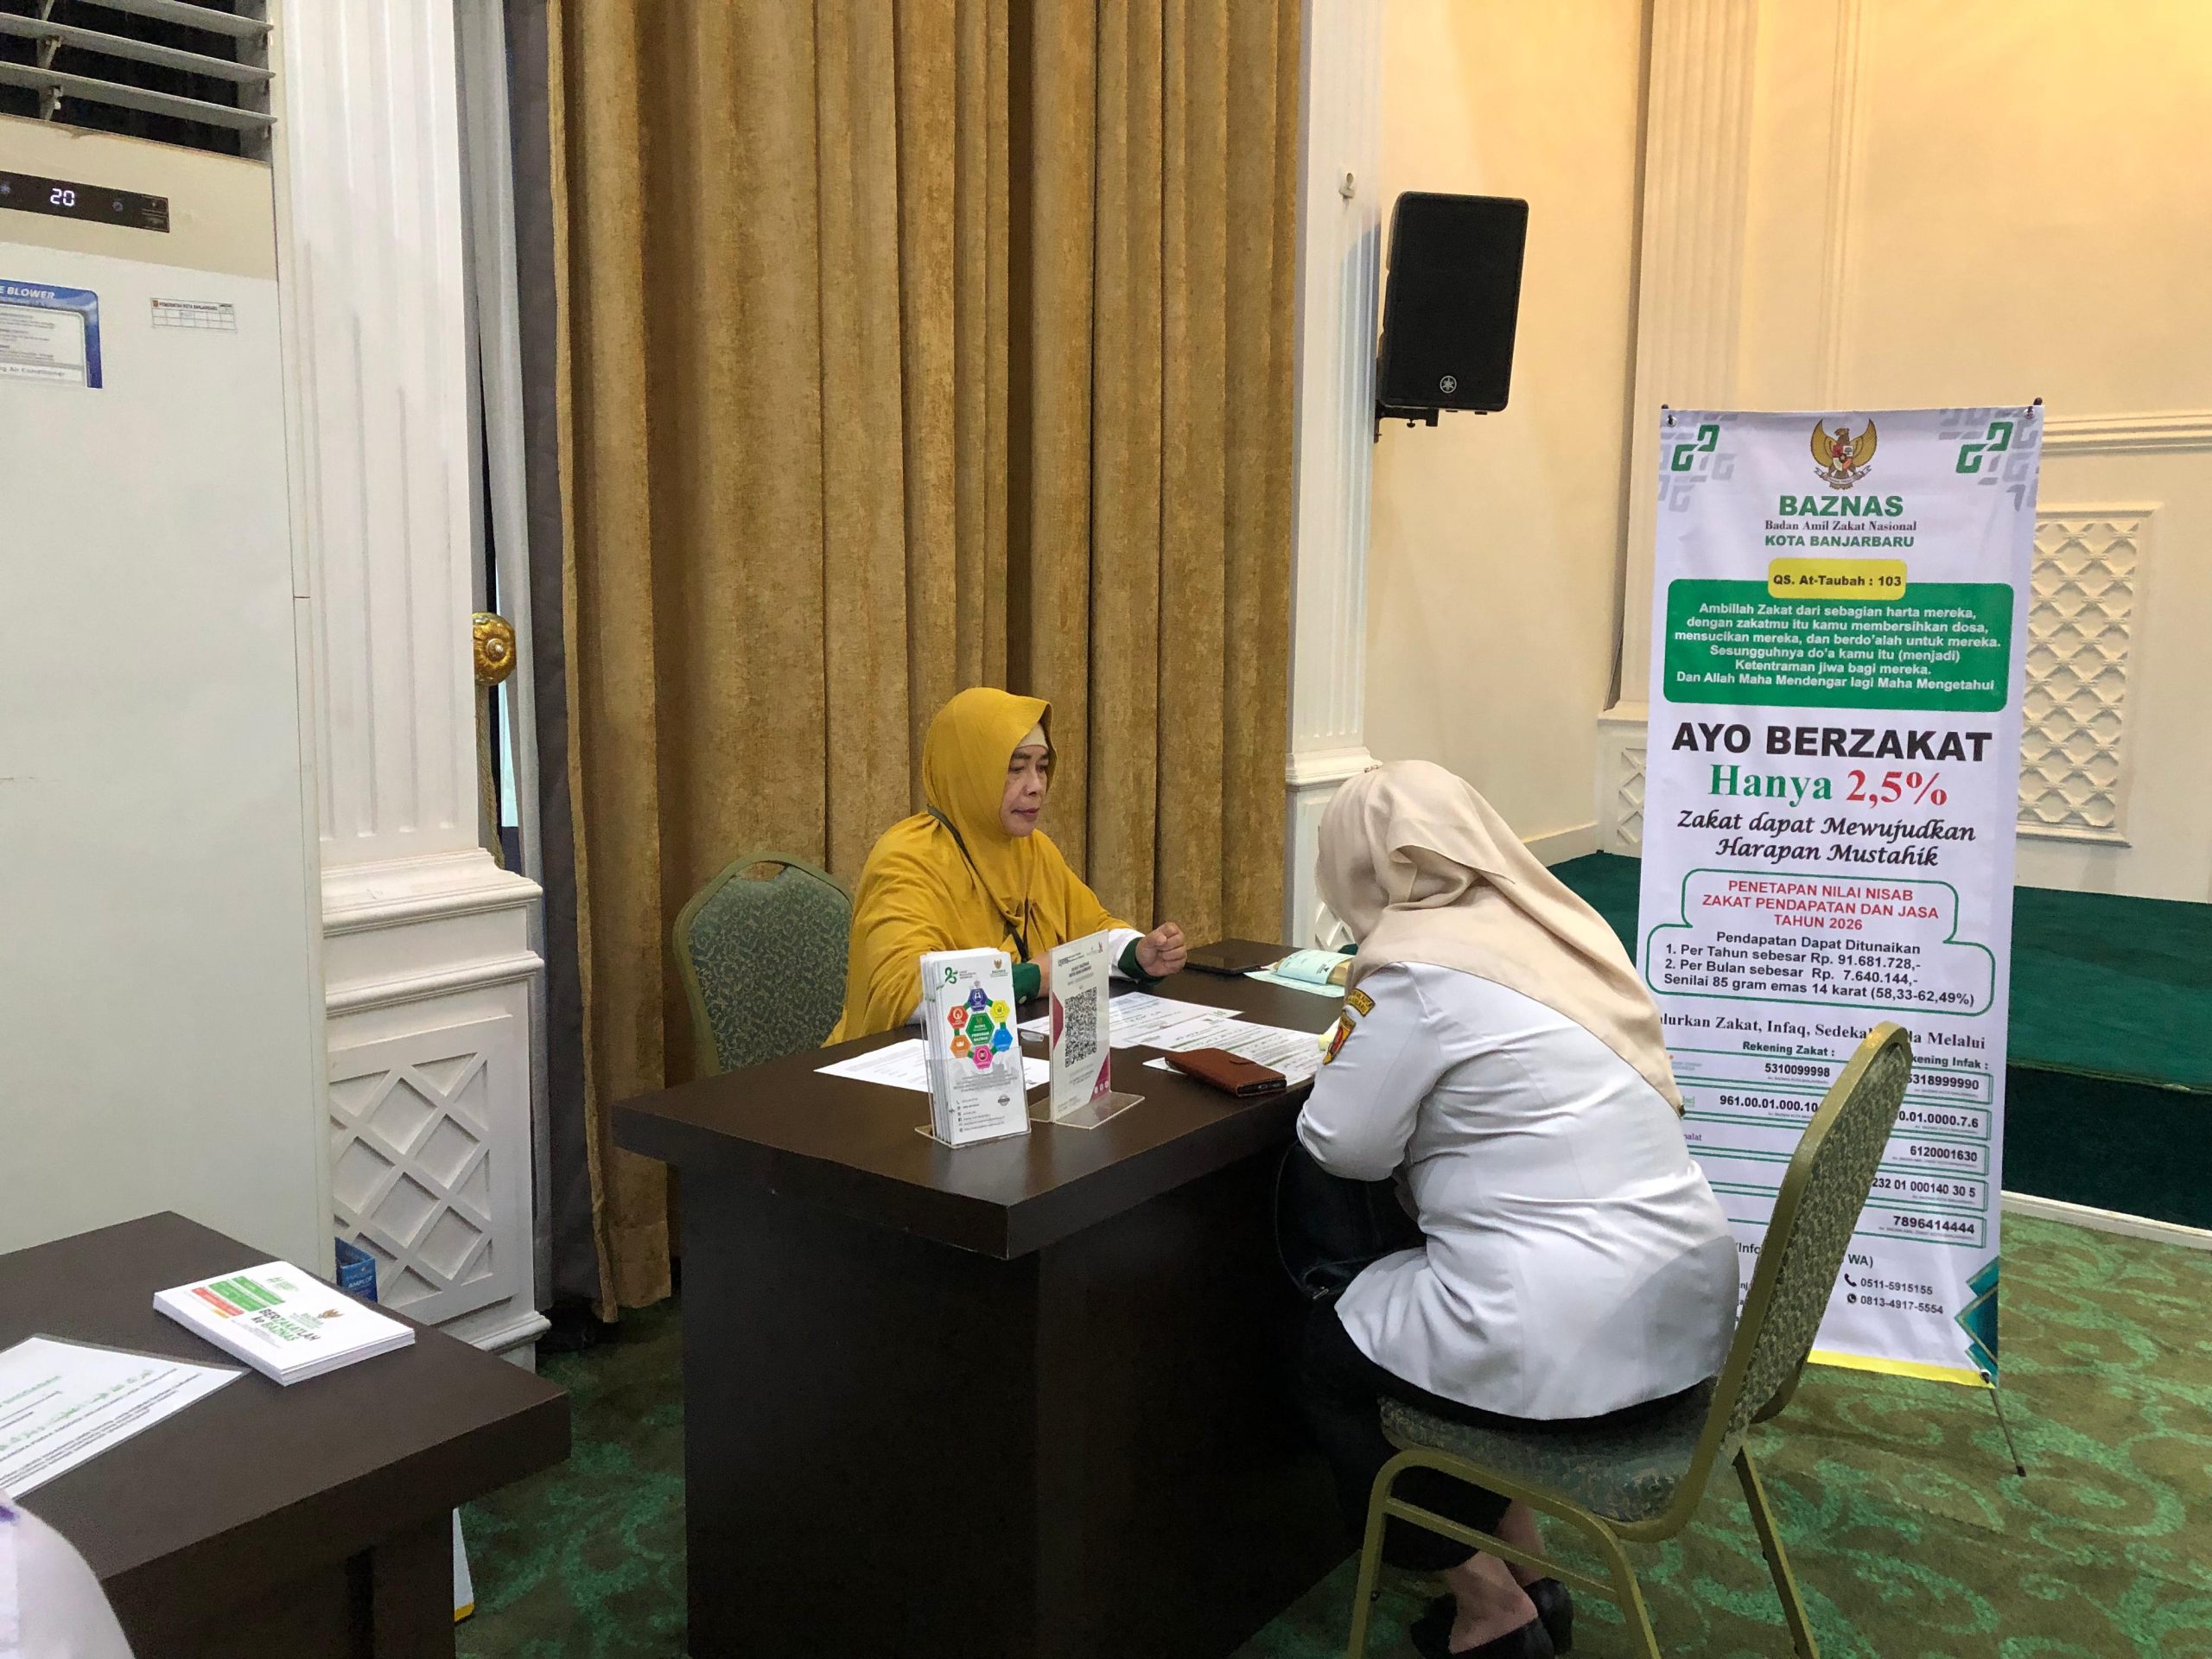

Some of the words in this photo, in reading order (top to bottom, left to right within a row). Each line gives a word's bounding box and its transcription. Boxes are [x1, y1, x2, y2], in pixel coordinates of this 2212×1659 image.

[50, 188, 76, 207] 20
[7, 286, 55, 299] BLOWER
[1779, 495, 1904, 517] BAZNAS
[1764, 520, 1799, 531] Badan
[1802, 520, 1829, 531] Amil
[1833, 520, 1865, 531] Zakat
[1869, 521, 1917, 531] Nasional
[1765, 536, 1805, 546] KOTA
[1810, 536, 1915, 547] BANJARBARU
[1773, 575, 1795, 585] QS.
[1799, 575, 1865, 586] At-Taubah
[1878, 576, 1902, 587] 103
[1699, 603, 1754, 614] Ambillah
[1758, 604, 1793, 615] Zakat
[1796, 606, 1821, 616] dari
[1824, 606, 1882, 619] sebagian
[1886, 607, 1920, 618] harta
[1924, 607, 1977, 620] mereka,
[1687, 617, 1733, 629] dengan
[1736, 618, 1789, 629] zakatmu
[1792, 619, 1808, 629] itu
[1812, 620, 1847, 631] kamu
[1851, 620, 1948, 632] membersihkan
[1952, 622, 1989, 634] dosa,
[1675, 631, 1749, 642] mensucikan
[1752, 633, 1802, 645] mereka,
[1806, 633, 1829, 645] dan
[1906, 635, 1944, 646] untuk
[1948, 637, 2001, 647] mereka.
[1710, 645, 1804, 660] Sesungguhnya
[1808, 646, 1835, 658] do'a
[1839, 648, 1874, 659] kamu
[1898, 650, 1961, 664] (menjadi)
[1735, 659, 1815, 672] Ketentraman
[1817, 661, 1845, 675] jiwa
[1848, 663, 1877, 676] bagi
[1879, 664, 1932, 675] mereka.
[1676, 671, 1700, 682] Dan
[1704, 672, 1735, 683] Allah
[1738, 674, 1772, 684] Maha
[1776, 675, 1847, 689] Mendengar
[1851, 677, 1873, 690] lagi
[1878, 677, 1913, 689] Maha
[1916, 678, 1994, 692] Mengetahui
[1672, 722, 1751, 753] AYO
[1766, 725, 1993, 762] BERZAKAT
[1708, 764, 1833, 808] Hanya
[1847, 770, 1948, 809] 2,5%
[1677, 810, 1742, 830] Zakat
[1749, 811, 1815, 838] dapat
[1820, 816, 1976, 843] Mewujudkan
[1715, 837, 1821, 864] Harapan
[1827, 843, 1940, 866] Mustahik
[1728, 880, 1817, 896] PENETAPAN
[1822, 885, 1861, 898] NILAI
[1866, 887, 1913, 900] NISAB
[1702, 894, 1751, 907] ZAKAT
[1756, 898, 1856, 913] PENDAPATAN
[1860, 903, 1893, 916] DAN
[1897, 906, 1939, 918] JASA
[1774, 914, 1825, 928] TAHUN
[1829, 918, 1863, 930] 2026
[1716, 931, 1796, 947] Pendapatan
[1801, 937, 1841, 950] Dapat
[1846, 939, 1921, 955] Ditunaikan
[1666, 944, 1676, 954] 1.
[1681, 944, 1704, 956] Per
[1707, 946, 1748, 959] Tahun
[1752, 950, 1807, 963] sebesar
[1810, 952, 1834, 966] Rp.
[1838, 954, 1921, 971] 91.681.728,-
[1665, 958, 1676, 969] 2.
[1680, 959, 1702, 971] Per
[1707, 962, 1745, 974] Bulan
[1750, 965, 1804, 978] sebesar
[1812, 968, 1834, 982] Rp.
[1843, 969, 1918, 986] 7.640.144,-
[1664, 974, 1709, 987] Senilai
[1713, 976, 1729, 988] 85
[1732, 979, 1767, 991] gram
[1770, 982, 1808, 993] emas
[1812, 983, 1827, 995] 14
[1832, 984, 1867, 997] karat
[1871, 987, 1974, 1007] (58,33-62,49%)
[1660, 1013, 1711, 1028] lurkan
[1715, 1017, 1762, 1033] Zakat,
[1767, 1020, 1810, 1038] Infaq,
[1815, 1023, 1873, 1039] Sedeka
[1743, 1041, 1793, 1055] Rekening
[1796, 1044, 1828, 1056] Zakat
[1928, 1032, 1986, 1049] Melalui
[1764, 1063, 1831, 1077] 5310099998
[1953, 1057, 1981, 1069] Infak
[1910, 1145, 1978, 1162] 6120001630
[1894, 1179, 1906, 1191] 01
[1910, 1181, 1949, 1194] 000140
[1953, 1185, 1966, 1196] 30
[1969, 1187, 1976, 1198] 5
[1893, 1216, 1974, 1235] 7896414444
[1848, 1254, 1873, 1268] WA)
[1860, 1278, 1933, 1295] 0511-5915155
[1860, 1295, 1943, 1314] 0813-4917-5554
